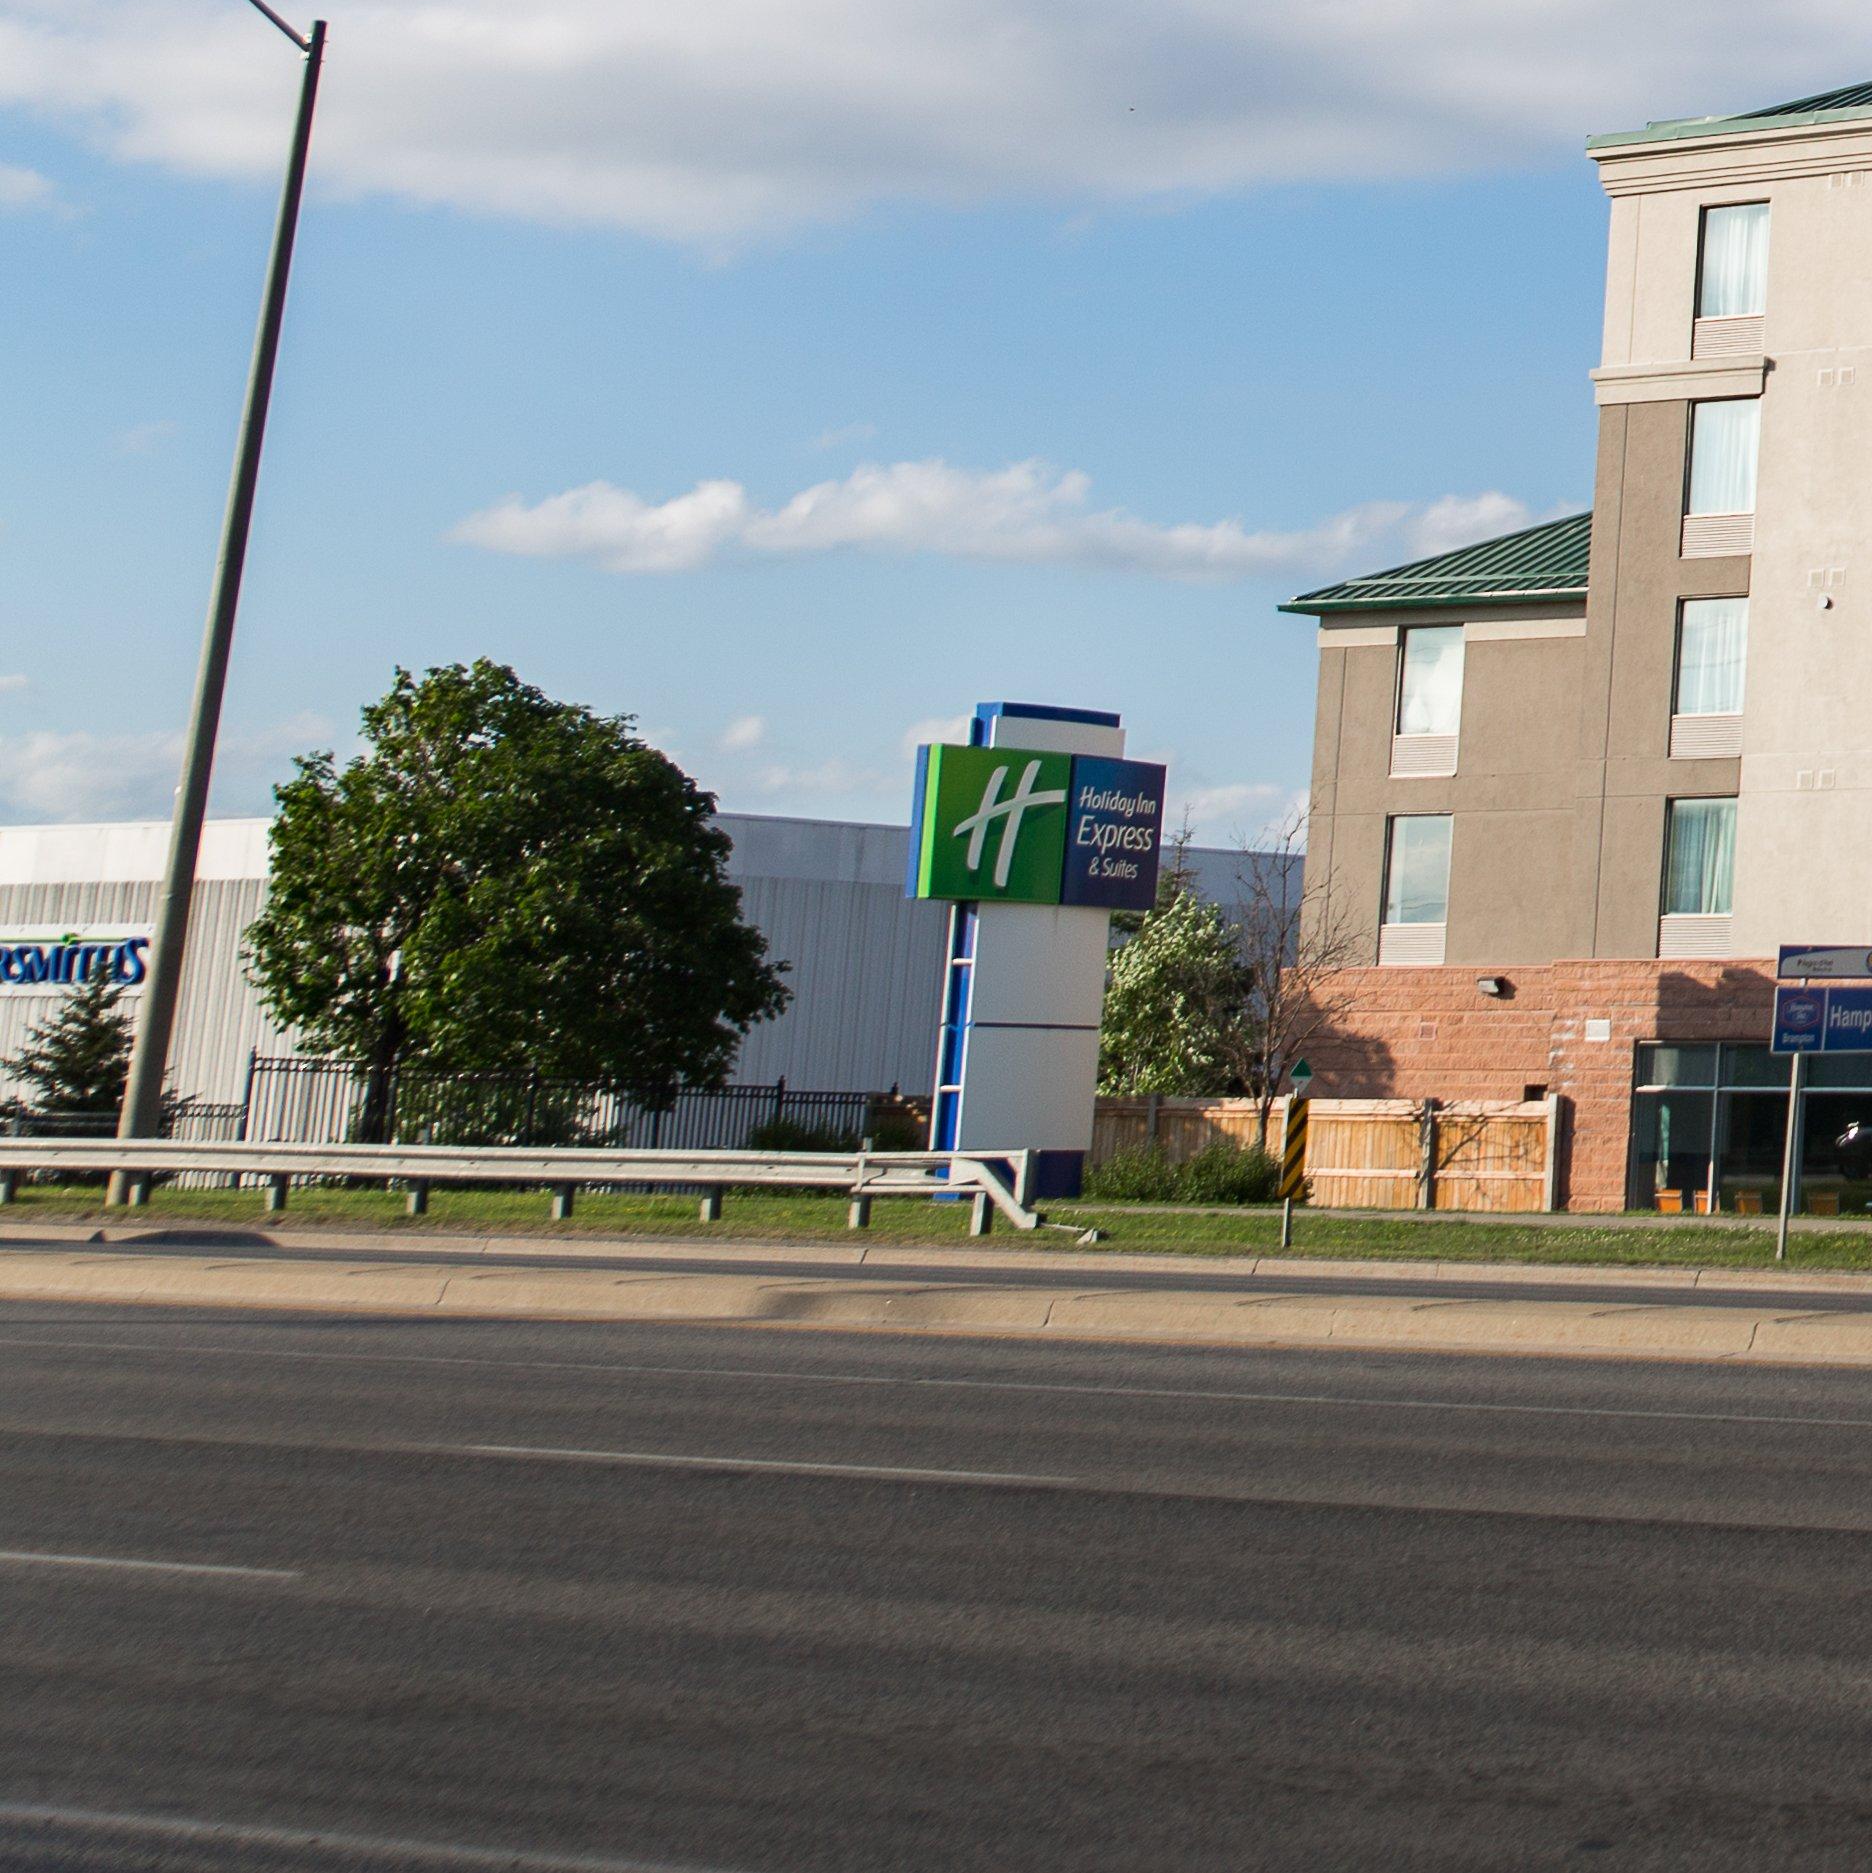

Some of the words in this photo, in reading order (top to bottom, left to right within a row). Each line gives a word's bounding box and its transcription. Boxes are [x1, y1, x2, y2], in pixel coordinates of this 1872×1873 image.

[1080, 786, 1137, 817] Holiday
[1136, 792, 1156, 814] Inn
[1077, 815, 1154, 855] Express
[1088, 856, 1100, 876] &
[1101, 857, 1139, 879] Suites
